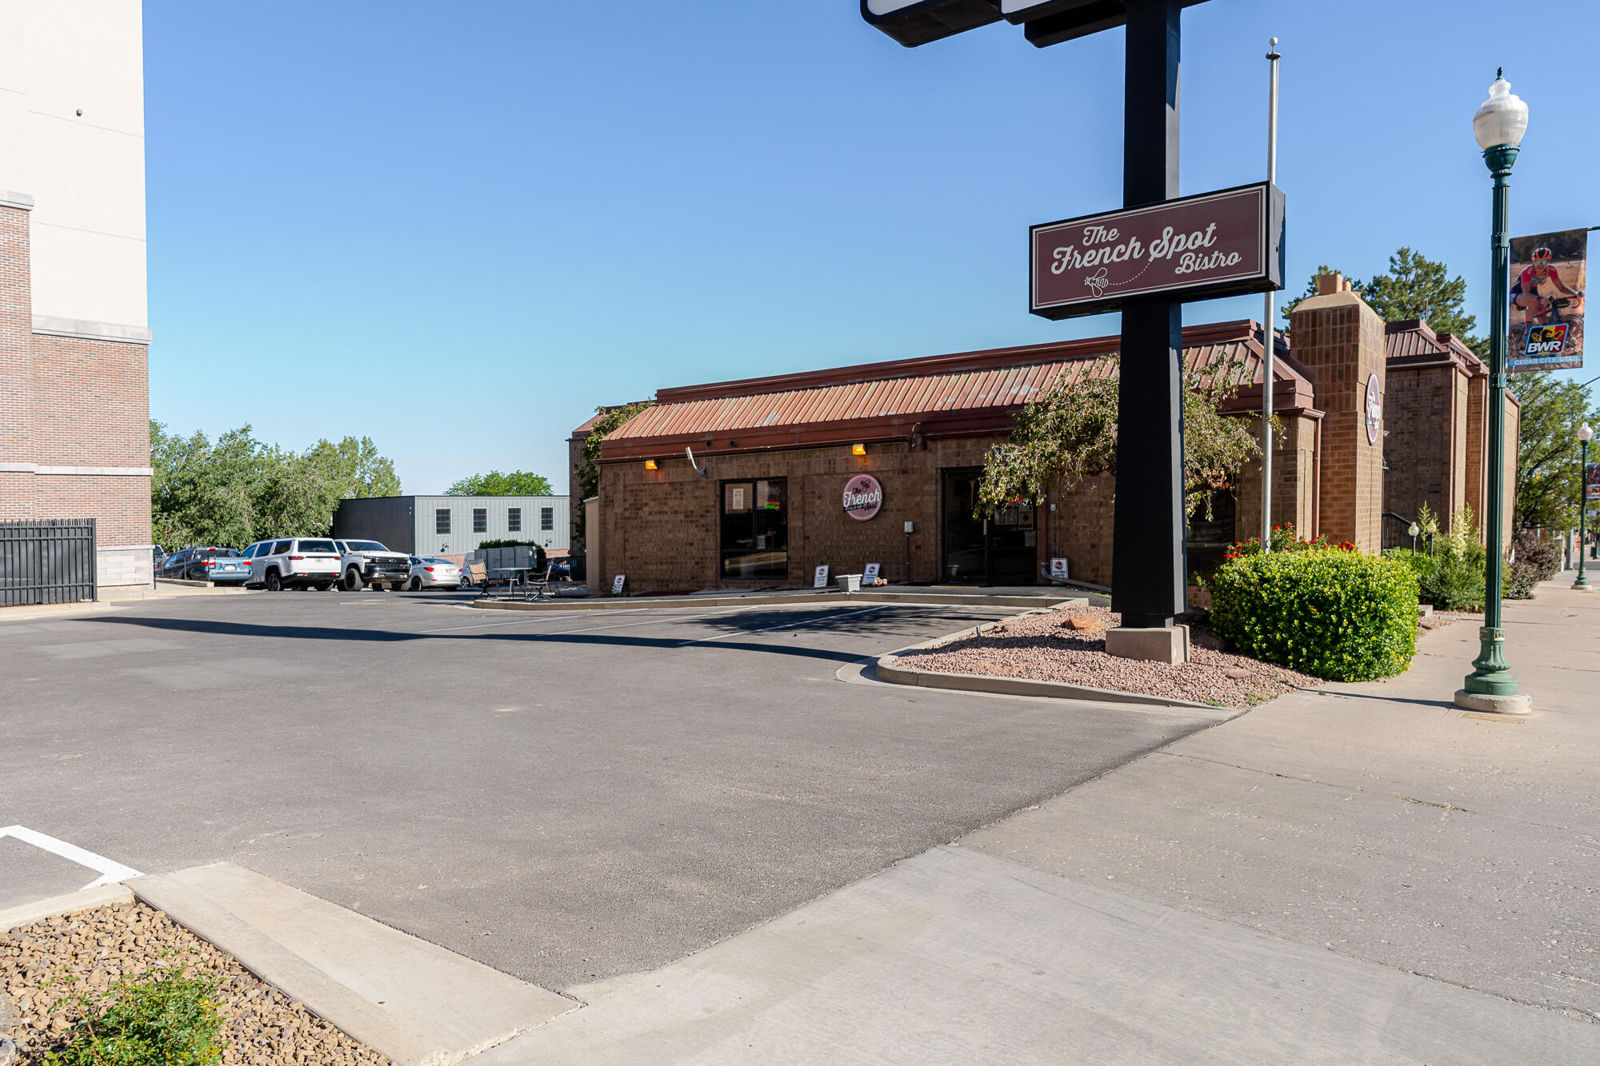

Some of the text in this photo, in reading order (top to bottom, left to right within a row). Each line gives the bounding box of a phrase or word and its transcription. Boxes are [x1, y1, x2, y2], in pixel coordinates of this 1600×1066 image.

[1082, 225, 1120, 246] The
[1050, 222, 1217, 275] French Spot
[1174, 251, 1242, 274] Bistro
[1528, 341, 1562, 353] BWR
[843, 489, 880, 507] French
